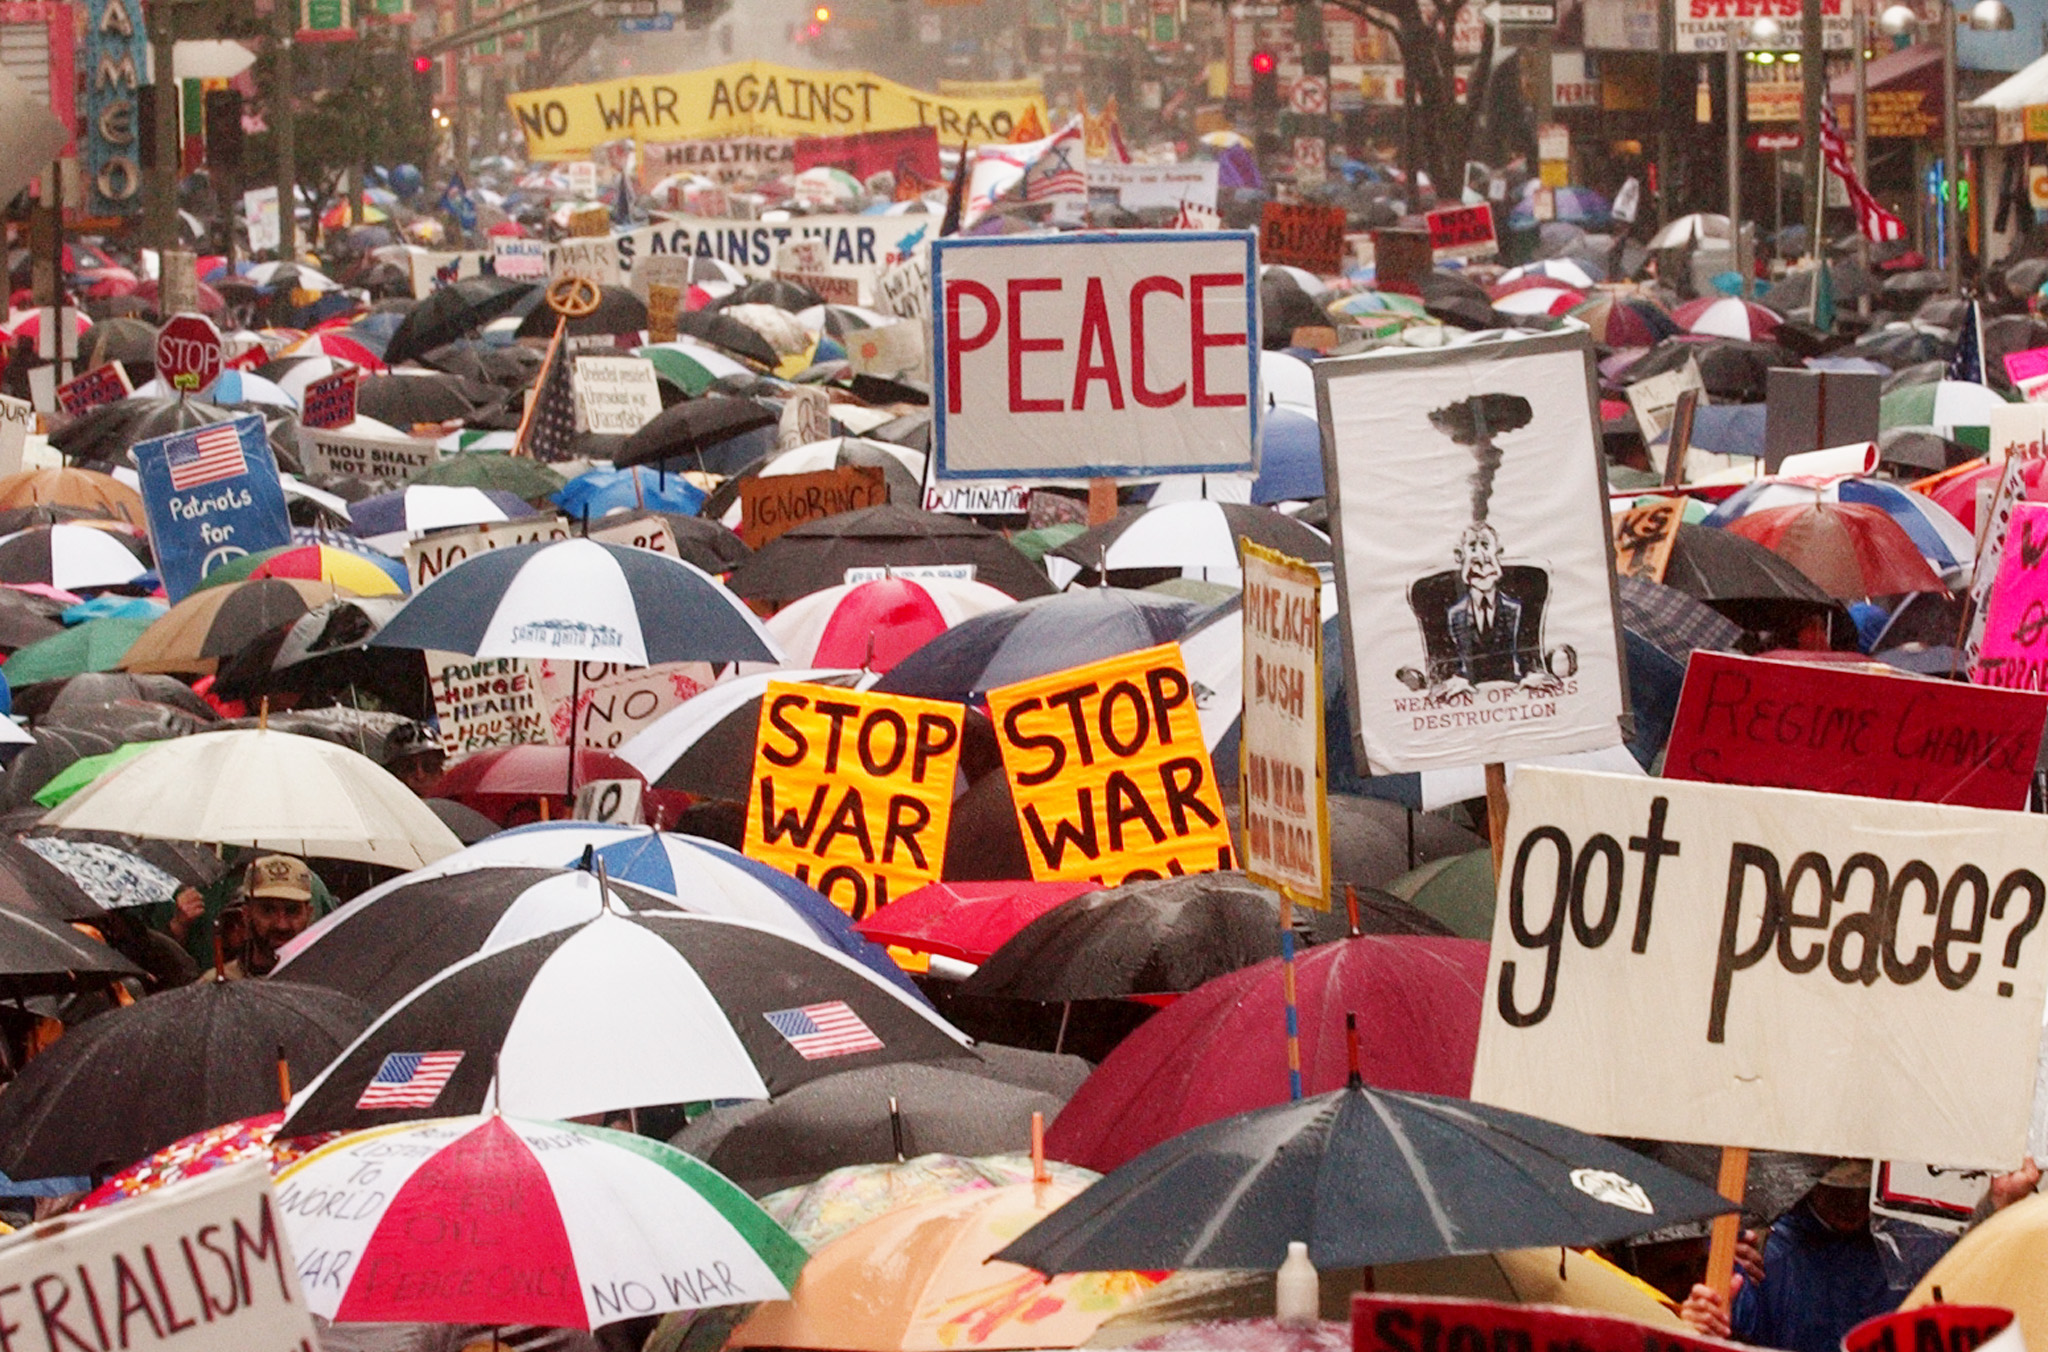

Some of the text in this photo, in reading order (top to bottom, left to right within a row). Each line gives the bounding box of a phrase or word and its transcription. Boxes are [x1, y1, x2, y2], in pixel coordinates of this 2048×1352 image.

[1690, 0, 1841, 18] STETSN
[516, 101, 568, 141] NO
[595, 86, 681, 132] WAR
[708, 73, 881, 124] AGAINST
[650, 227, 792, 268] AGAINST
[159, 334, 221, 375] STOP
[946, 273, 1248, 414] PEACE
[316, 442, 429, 467] THOU SHALT
[329, 459, 368, 475] NOT
[169, 487, 253, 521] Patriots
[200, 522, 236, 545] for
[443, 656, 529, 685] POVERT
[1255, 653, 1304, 720] BUSH
[583, 689, 659, 731] NO
[1393, 680, 1579, 713] WEAPON OF MASS
[1412, 702, 1558, 732] DESTRUCTION
[1698, 668, 1880, 756] REGIME
[761, 694, 957, 784] STOP
[1003, 666, 1189, 787] STOP
[760, 776, 931, 871] WAR
[1022, 756, 1221, 872] WAR
[1497, 796, 2047, 1044] got peace?
[348, 1161, 383, 1185] TO
[279, 1182, 385, 1221] WORLD
[404, 1214, 501, 1248] OIL
[591, 1259, 746, 1316] NO WAR
